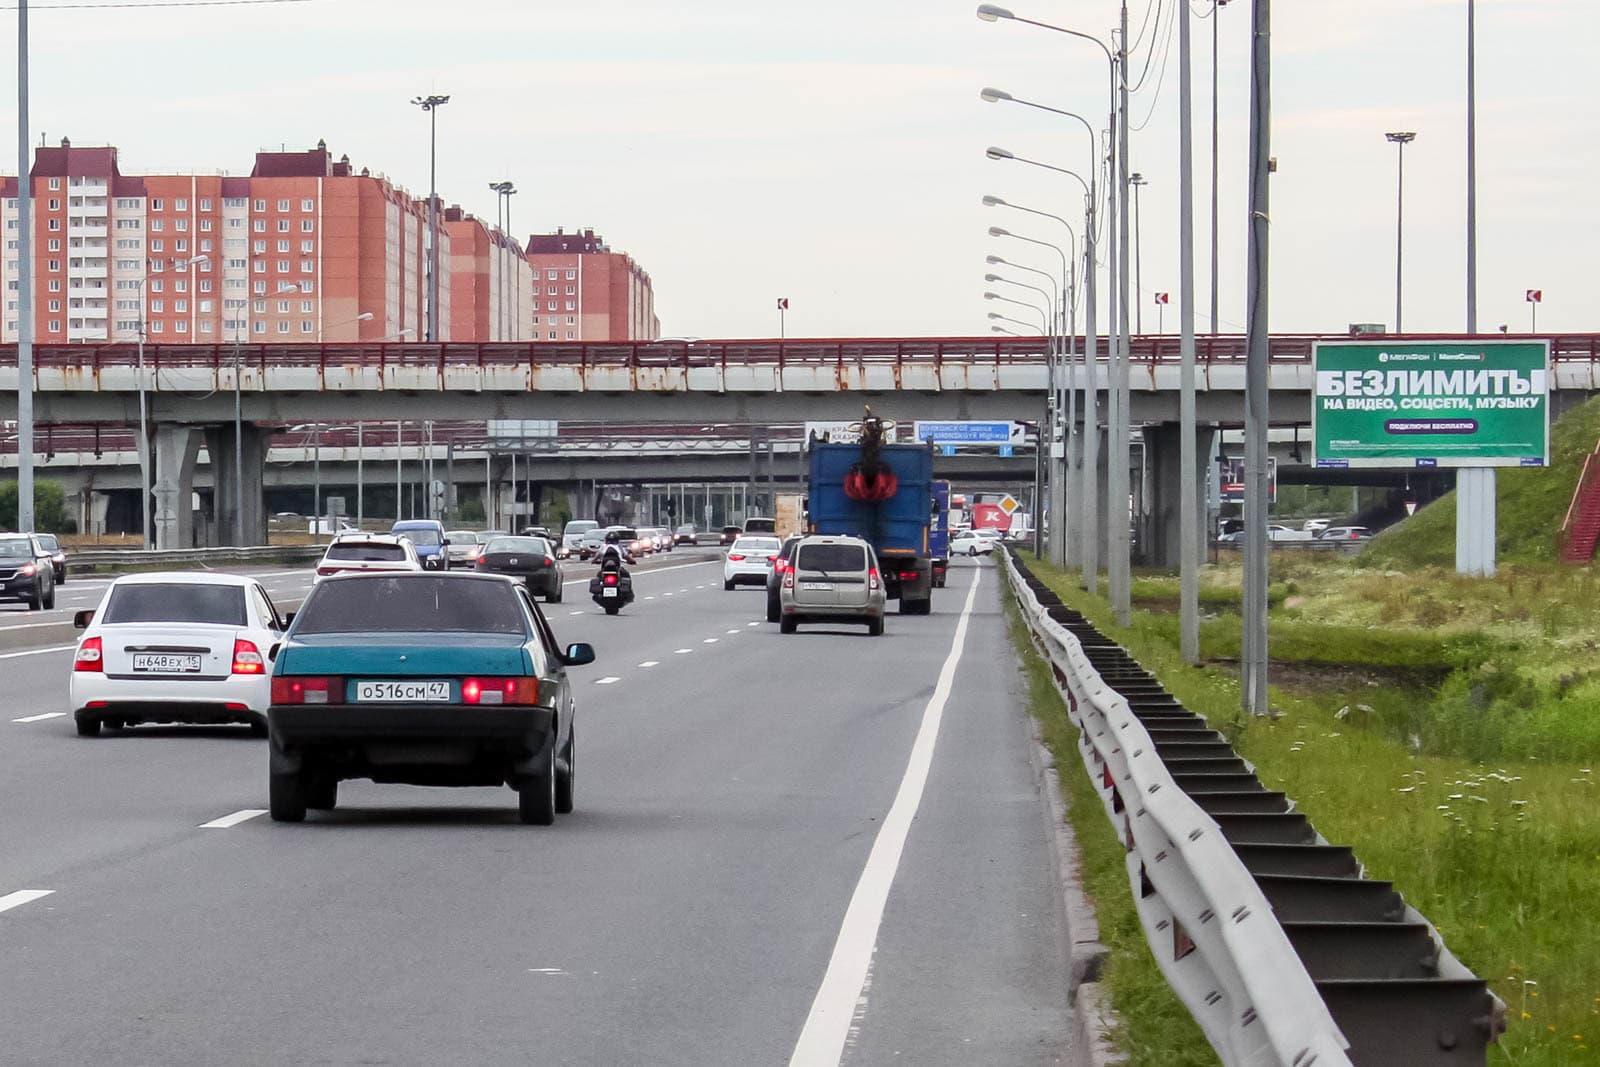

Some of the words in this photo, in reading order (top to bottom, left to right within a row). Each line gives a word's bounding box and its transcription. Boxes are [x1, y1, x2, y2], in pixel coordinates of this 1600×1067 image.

[1316, 370, 1546, 396] БЕЗЛИМИТЫ
[1323, 398, 1344, 410] НА
[1346, 397, 1398, 411] ВИДЕО,
[1400, 397, 1473, 411] СОЦСЕТИ,
[1475, 397, 1539, 409] МУЗЫКУ
[363, 683, 425, 698] О516СМ
[429, 683, 445, 694] 47
